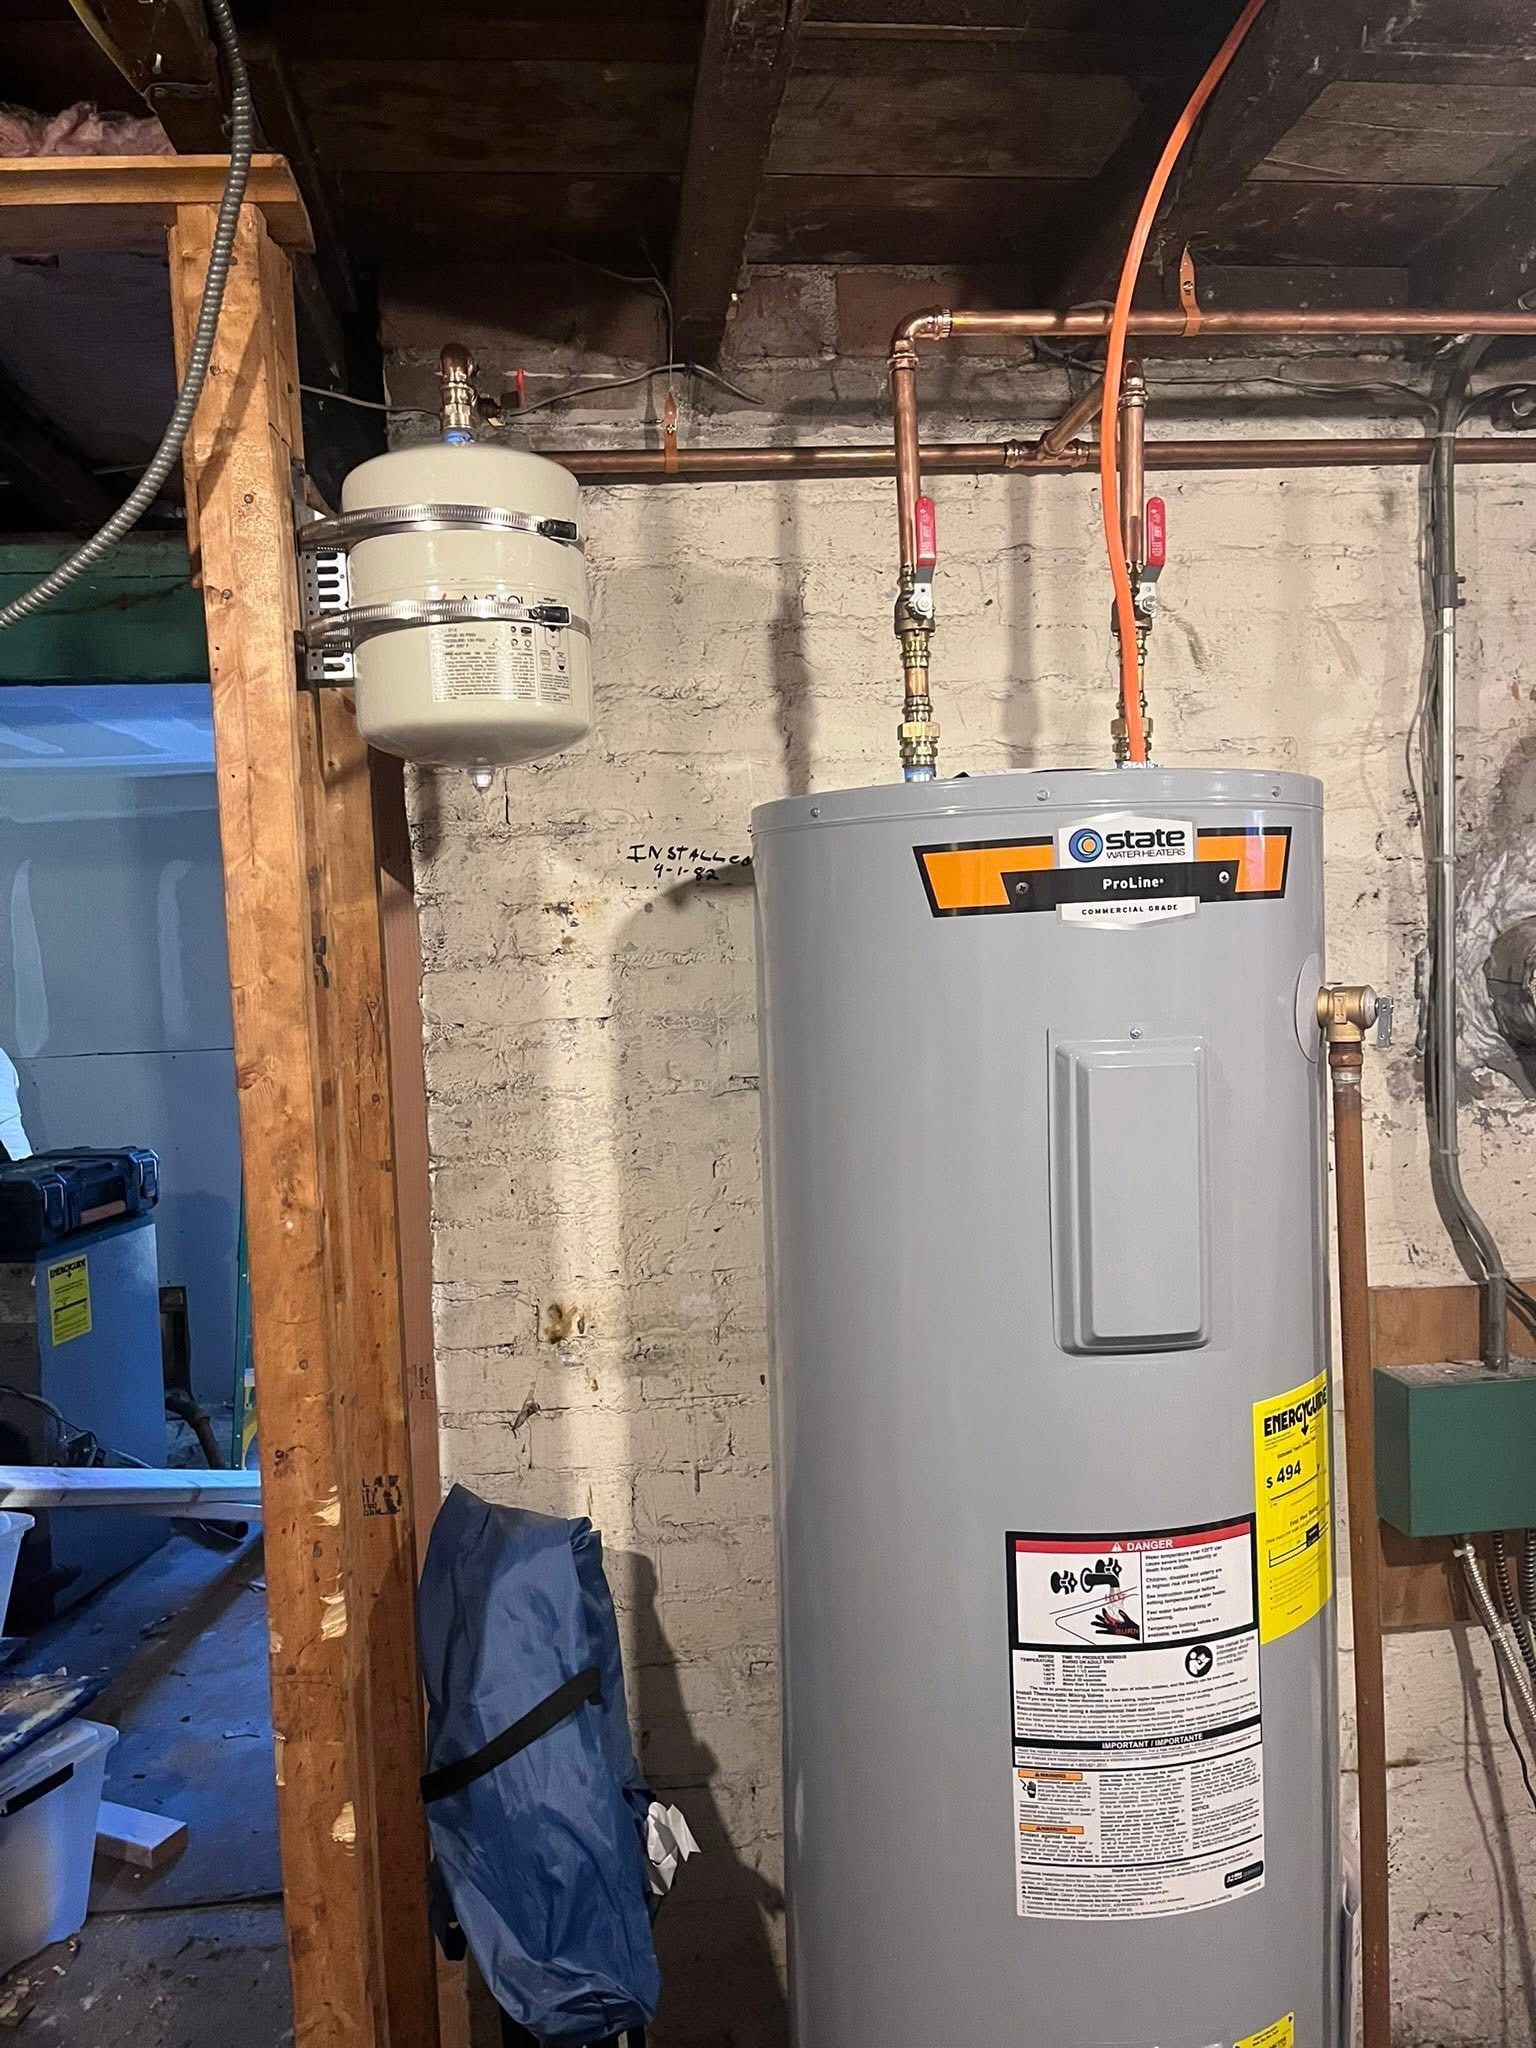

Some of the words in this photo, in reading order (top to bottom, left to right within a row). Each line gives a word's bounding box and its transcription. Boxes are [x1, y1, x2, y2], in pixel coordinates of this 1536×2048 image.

[1106, 829, 1185, 850] state
[1106, 850, 1140, 859] WATER
[1142, 848, 1186, 857] HEATERS
[1081, 906, 1144, 915] COMMERCIAL
[1148, 904, 1178, 912] GRADE
[1276, 1459, 1302, 1483] 494
[1126, 1539, 1173, 1551] DANGER
[1102, 1740, 1148, 1749] IMPORTANT
[1155, 1733, 1203, 1746] IMPORTANTE
